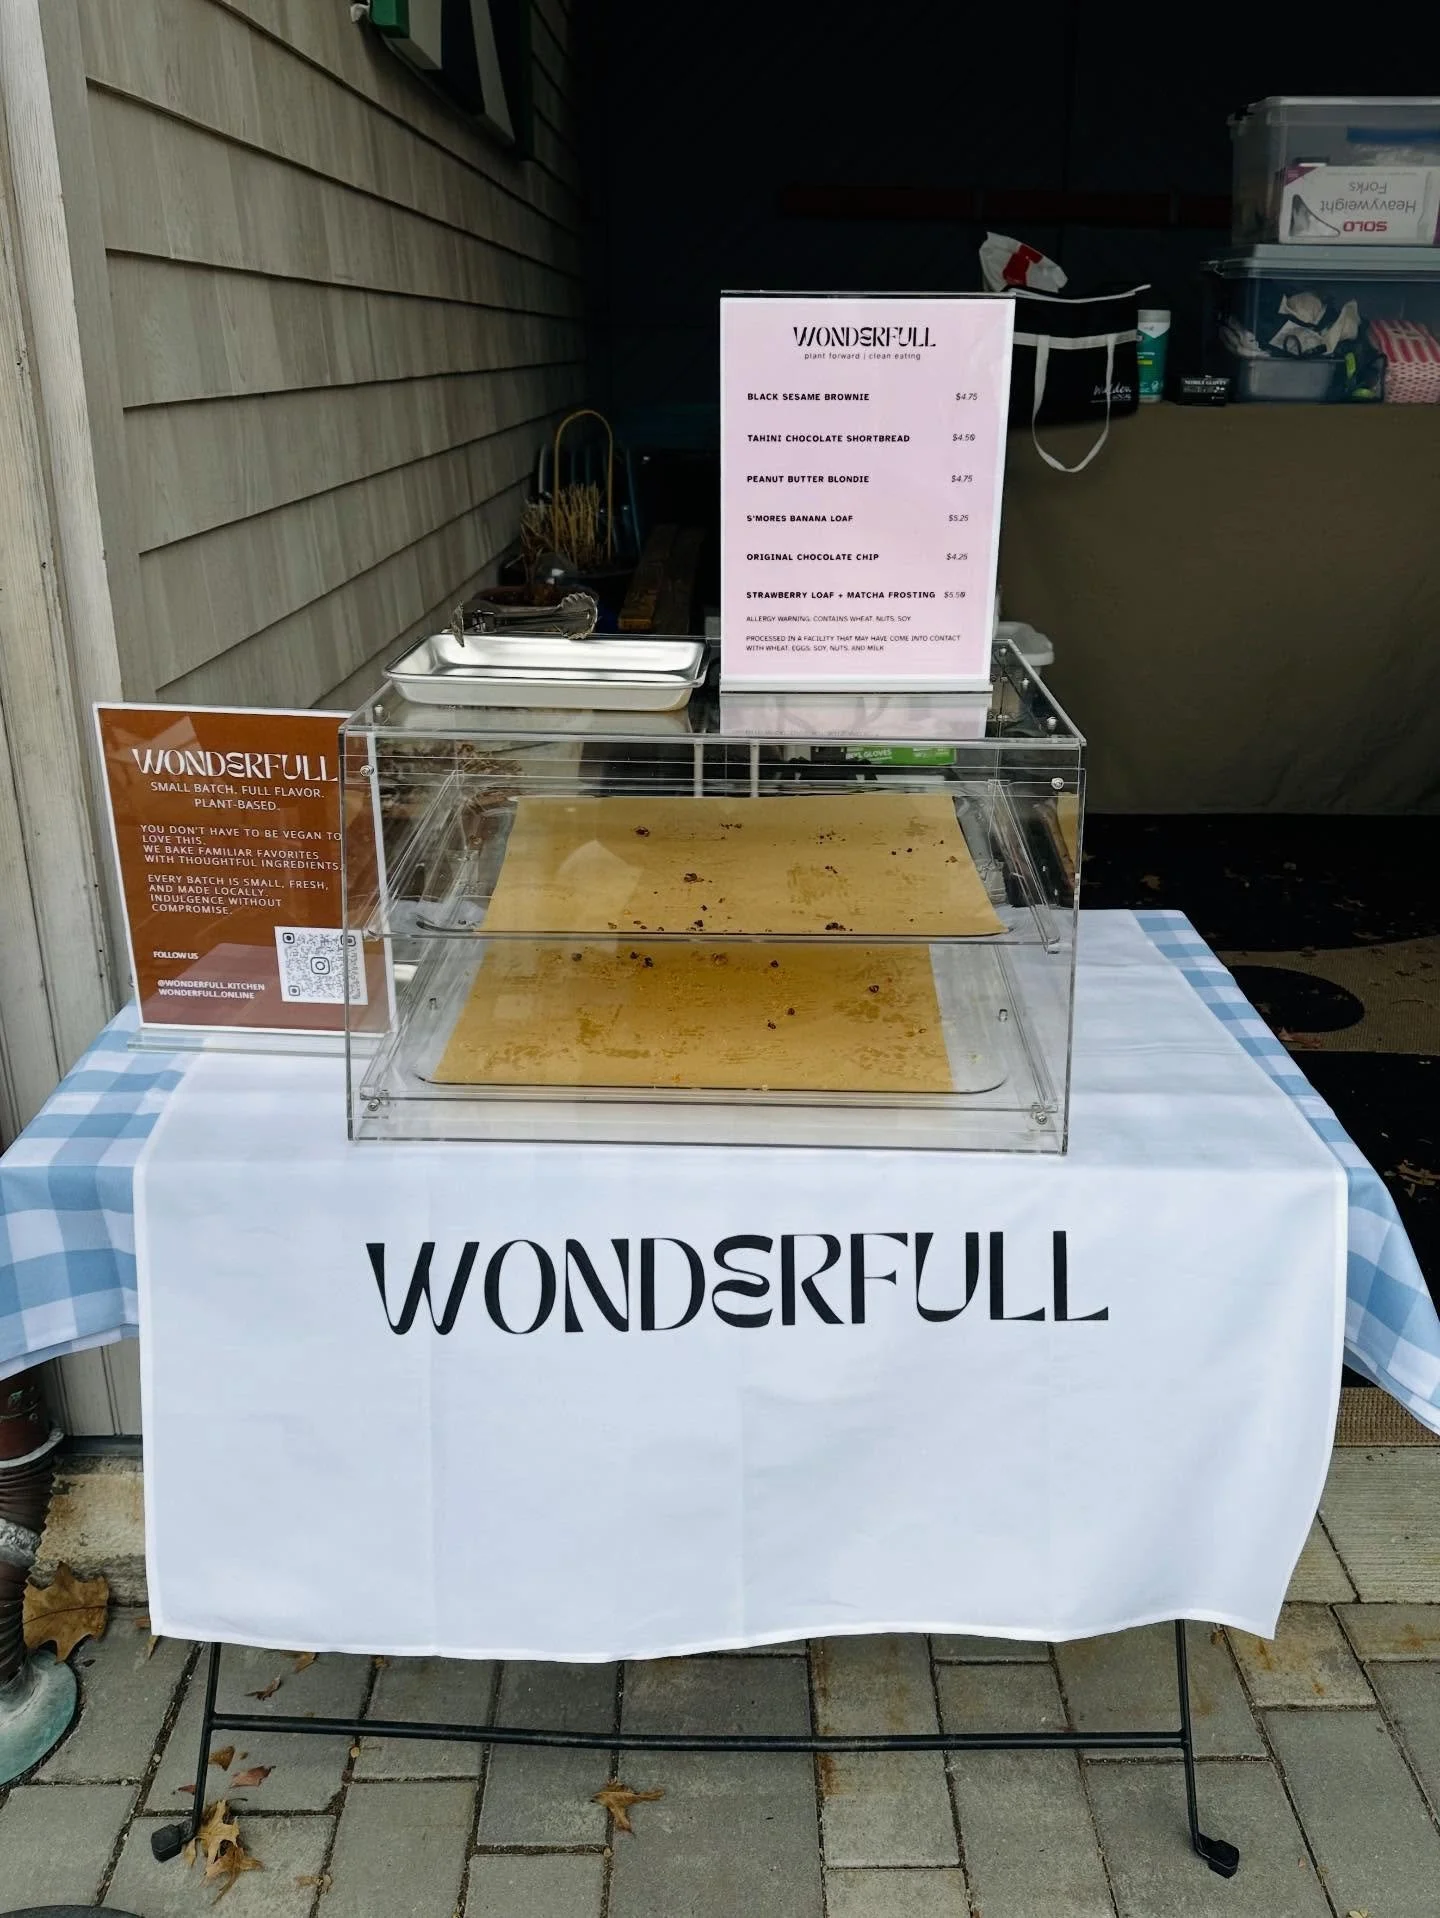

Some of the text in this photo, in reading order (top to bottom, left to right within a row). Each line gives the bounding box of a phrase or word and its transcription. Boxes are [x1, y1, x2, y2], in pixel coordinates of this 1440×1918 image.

[1350, 181, 1387, 194] Forks
[1320, 198, 1416, 213] Heavyweight
[1343, 221, 1387, 232] SOLO
[793, 327, 936, 347] WONDERFULL
[747, 393, 978, 401] BLACK SESAME BROWNIE $4.75
[748, 433, 975, 442] TAHINI CHOCOLATE SHORTBREAD $4.50
[747, 475, 784, 483] PEANUT
[788, 475, 824, 483] BUTTER
[828, 475, 869, 483] BLONDIE
[948, 514, 969, 522] $5.25
[747, 553, 968, 561] ORIGINAL CHOCOLATE CHIP $4.25
[747, 591, 807, 599] STRAWBERRY
[811, 591, 834, 599] LOAF
[847, 591, 884, 599] MATCHA
[888, 591, 935, 599] FROSTING
[132, 748, 338, 782] WONDERFULL
[151, 781, 324, 798] SMALL BATCH. FULL FLAVOR.
[194, 798, 280, 811] PLANT-BASED.
[140, 824, 342, 841] YOU DON'T HAVE TO BE VEGAN TO
[142, 835, 206, 845] LOVE THIS.
[143, 845, 318, 860] WE BAKE FAMILIAR FAVORITES
[144, 854, 174, 863] WITH
[178, 855, 257, 867] THOUGHTFUL
[147, 874, 182, 884] EVERY
[187, 876, 224, 885] BATCH
[229, 878, 240, 886] IS
[289, 880, 328, 891] FRESH,
[149, 885, 268, 897] AND MADE LOCALLY.
[150, 894, 282, 907] INDULGENCE WITHOUT
[151, 904, 232, 915] COMPROMISE.
[153, 951, 188, 959] FOLLOW
[158, 988, 255, 999] WONDERFULL.ONLINE
[366, 1230, 1109, 1336] WONDERFULL
